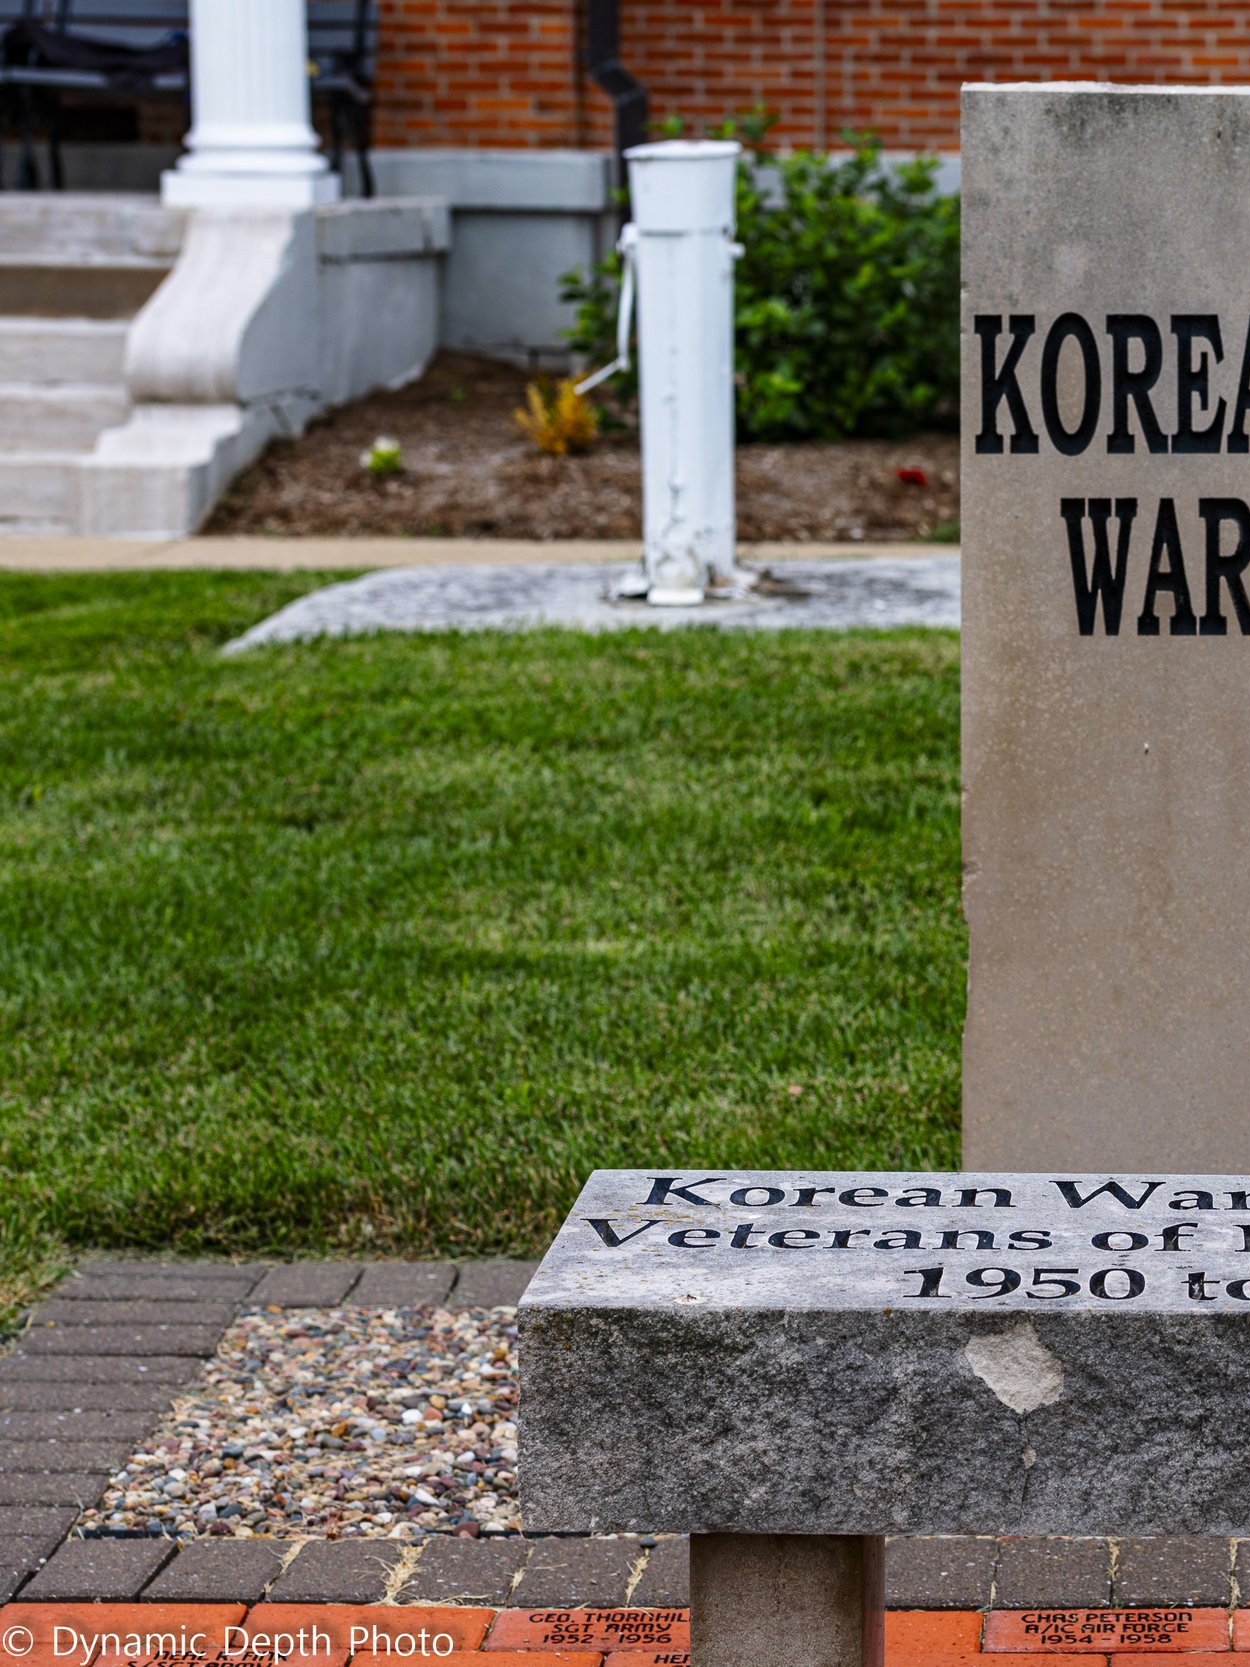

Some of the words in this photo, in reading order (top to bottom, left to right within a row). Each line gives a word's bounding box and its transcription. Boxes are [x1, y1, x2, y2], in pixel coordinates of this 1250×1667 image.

[636, 1177, 1015, 1208] Korean
[580, 1218, 1052, 1251] Veterans
[1091, 1222, 1198, 1252] of
[902, 1266, 1146, 1300] 1950
[529, 1613, 576, 1623] GEO.
[584, 1612, 690, 1623] THORNHIL
[1021, 1613, 1079, 1623] CHAS
[1085, 1612, 1193, 1623] PETERSON
[604, 1623, 672, 1634] ARMY
[1081, 1624, 1116, 1634] AIR
[1122, 1623, 1190, 1633] FORCE
[542, 1634, 594, 1645] 1952
[618, 1634, 673, 1645] 1956
[1040, 1635, 1094, 1645] 1954
[1120, 1634, 1173, 1644] 1958
